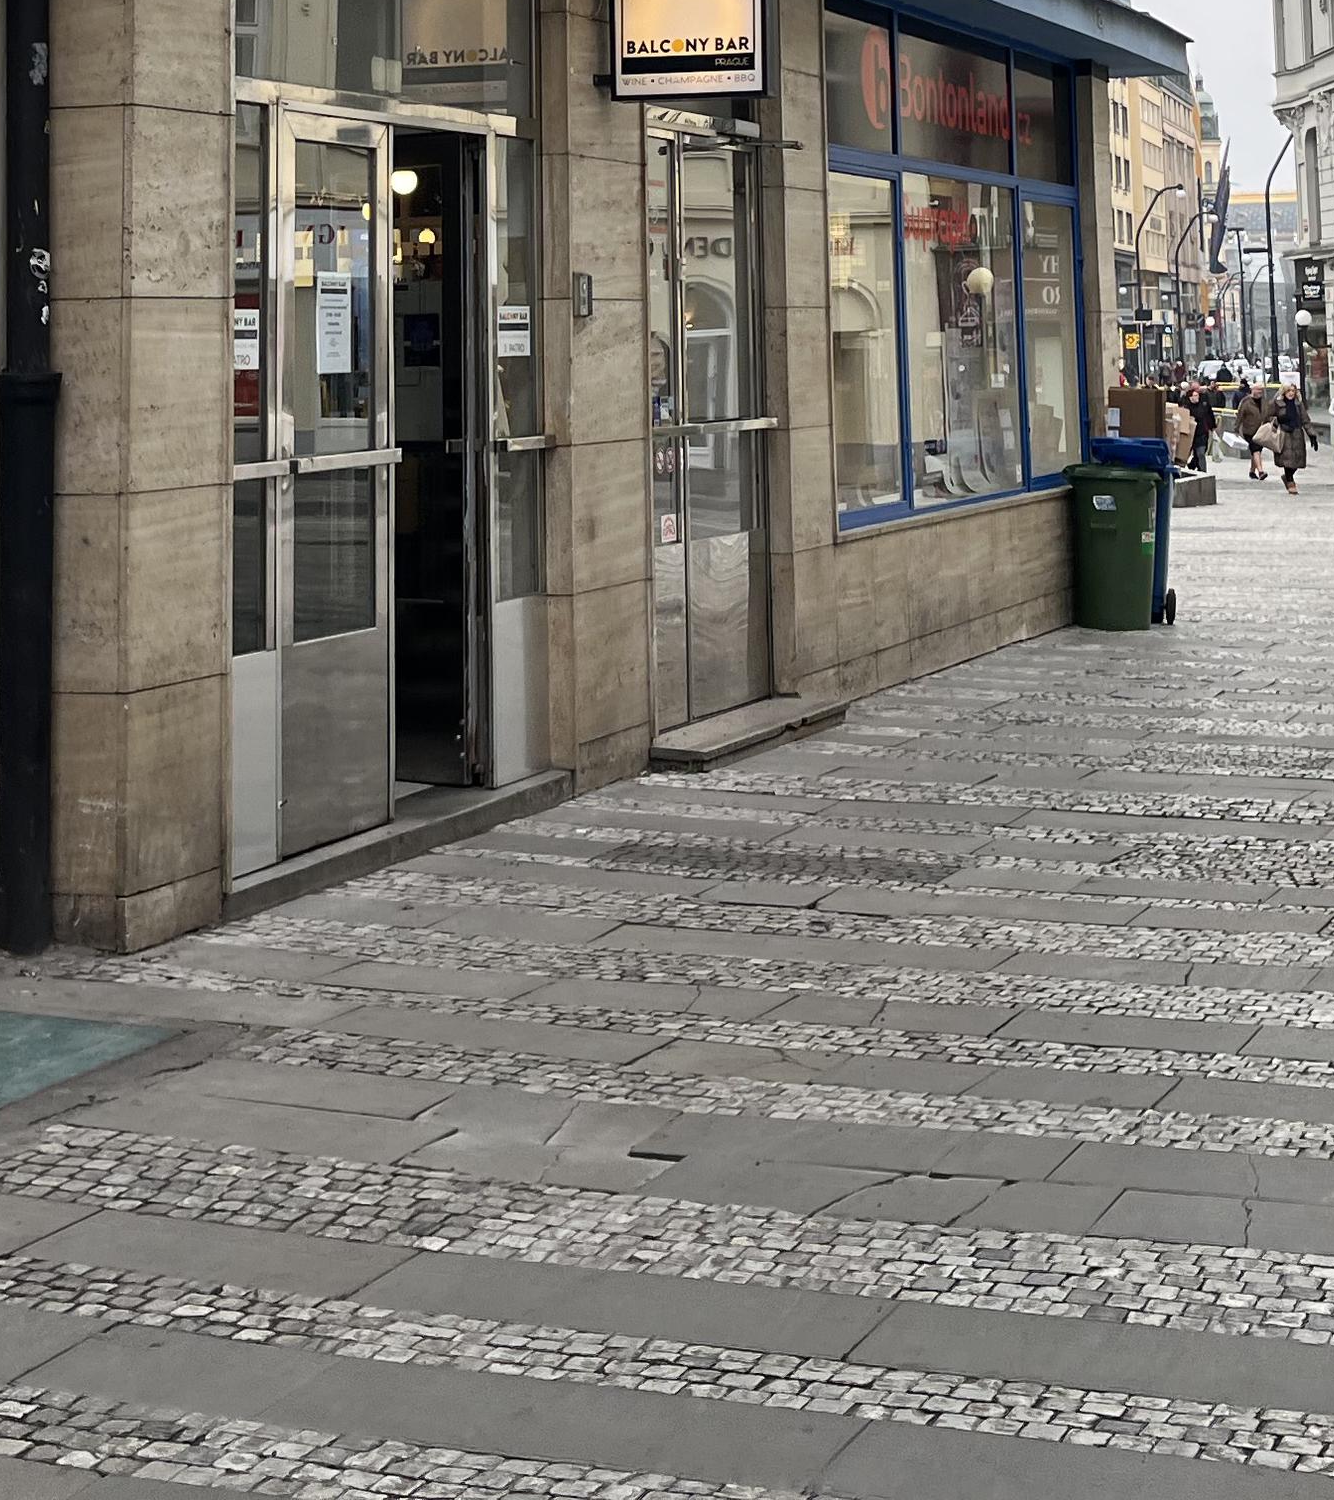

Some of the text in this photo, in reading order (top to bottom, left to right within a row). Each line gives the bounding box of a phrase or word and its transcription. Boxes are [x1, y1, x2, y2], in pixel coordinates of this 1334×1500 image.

[626, 36, 750, 55] BALCONY BAR
[714, 56, 750, 67] PRAGUE
[622, 73, 756, 87] WINE CHAMPAGNE BBQ
